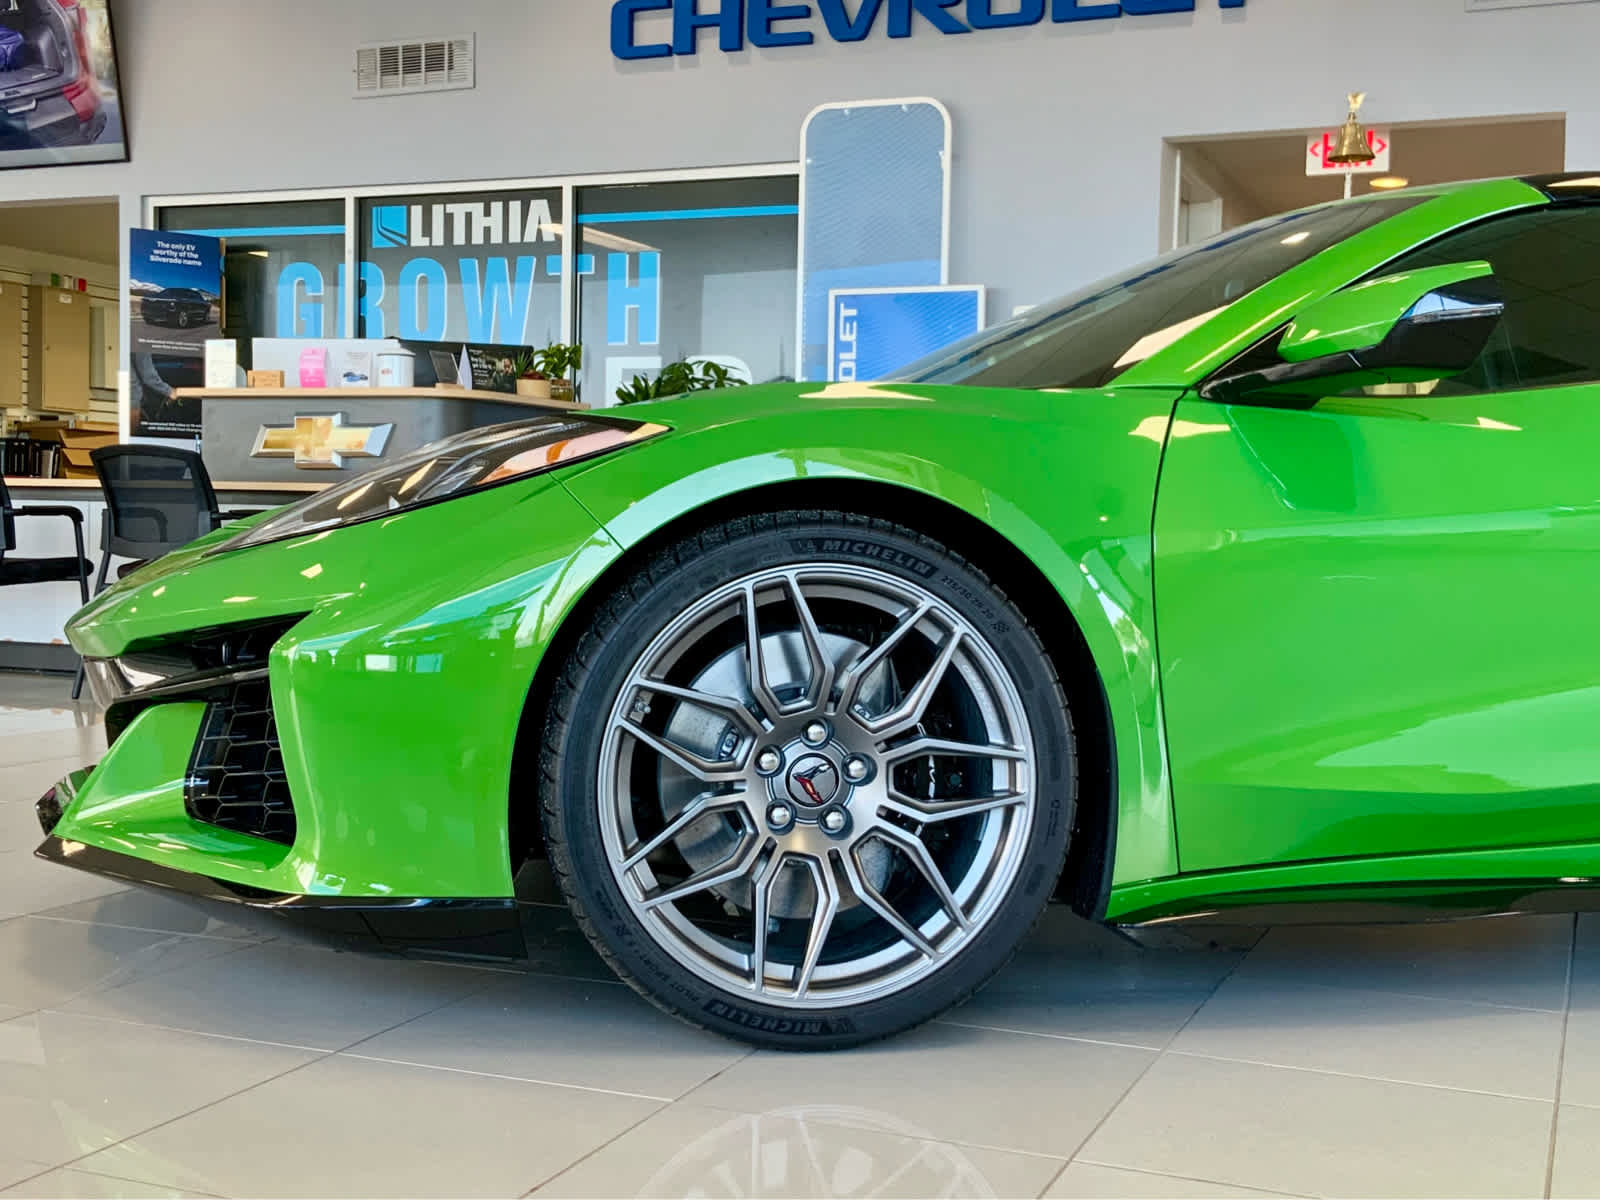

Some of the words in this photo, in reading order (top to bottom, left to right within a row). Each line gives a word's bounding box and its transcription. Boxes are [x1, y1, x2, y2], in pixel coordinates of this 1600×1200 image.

[611, 0, 1246, 60] CHEVR
[410, 199, 556, 247] LITHIA
[157, 241, 170, 250] The
[171, 243, 185, 251] only
[822, 539, 935, 574] MICHELIN
[710, 1002, 824, 1034] MICHELIN
